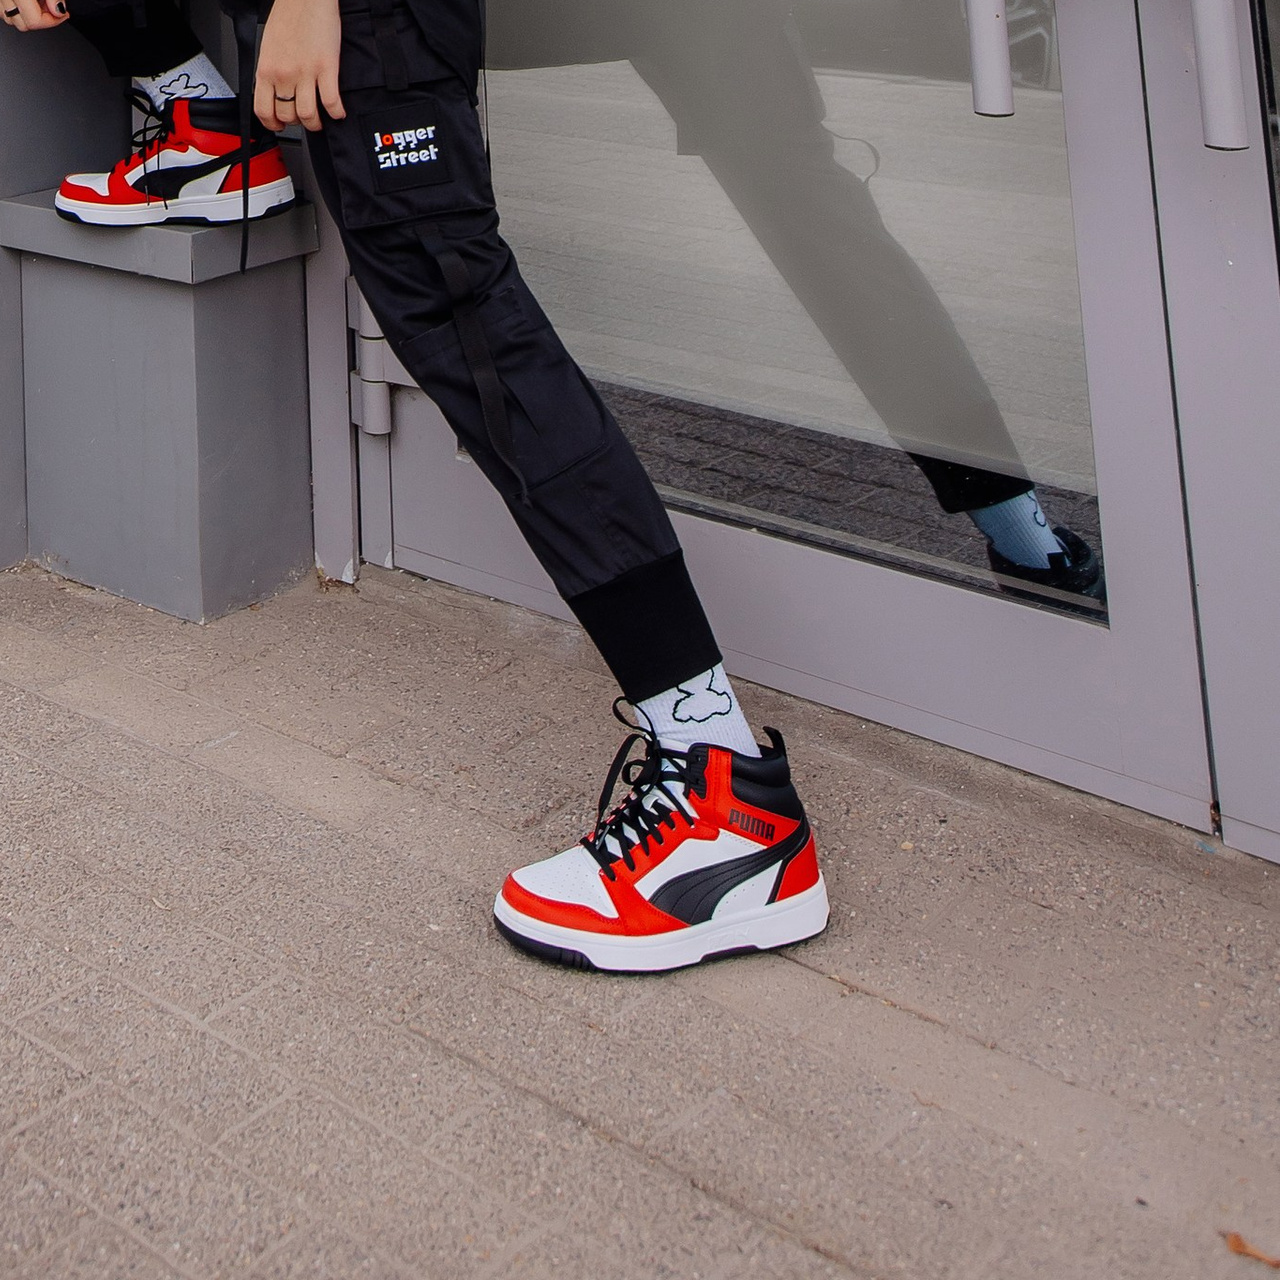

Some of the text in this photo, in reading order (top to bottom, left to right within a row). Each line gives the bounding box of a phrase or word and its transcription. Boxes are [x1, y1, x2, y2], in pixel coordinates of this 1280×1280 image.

[374, 126, 436, 152] Jogger
[377, 144, 439, 169] Street
[728, 808, 776, 842] PUMA
